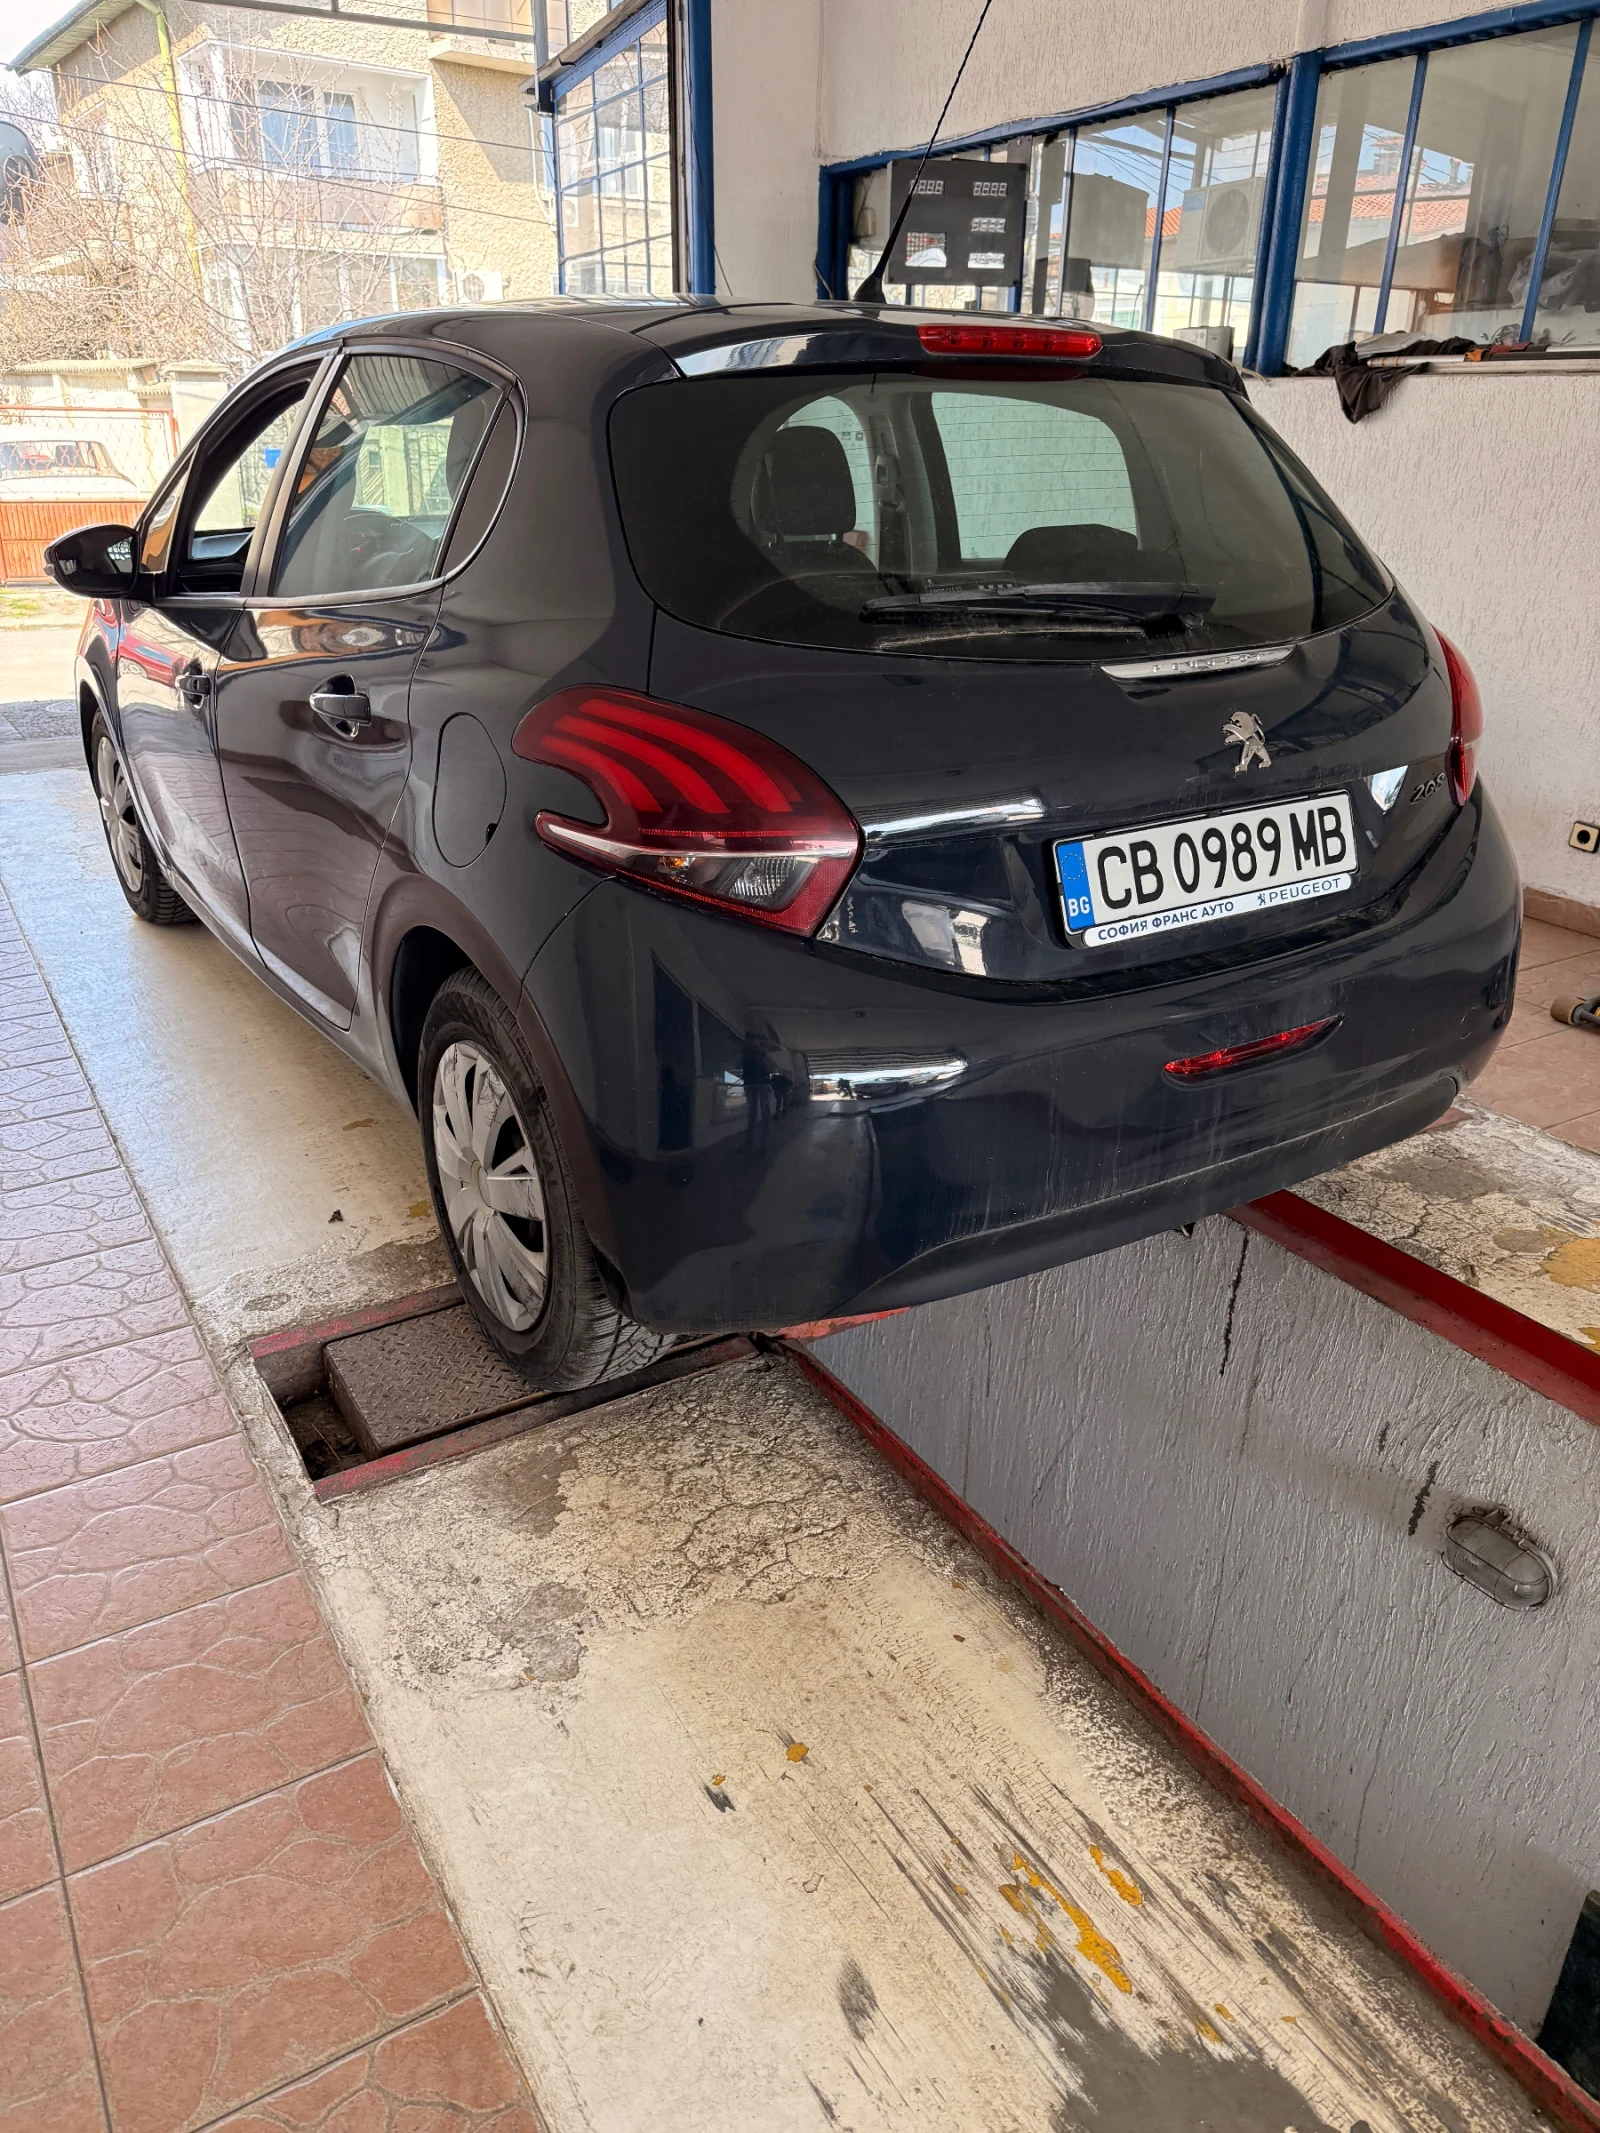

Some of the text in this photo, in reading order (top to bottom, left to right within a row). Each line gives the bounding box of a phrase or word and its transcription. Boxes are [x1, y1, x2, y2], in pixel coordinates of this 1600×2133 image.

[1410, 772, 1446, 804] 208
[1097, 806, 1347, 910] CB 0989 MB
[1268, 877, 1341, 902] PEUGEOT
[1067, 896, 1091, 917] BG
[1098, 901, 1234, 940] СОФИЯ ФРАНС АУТО
